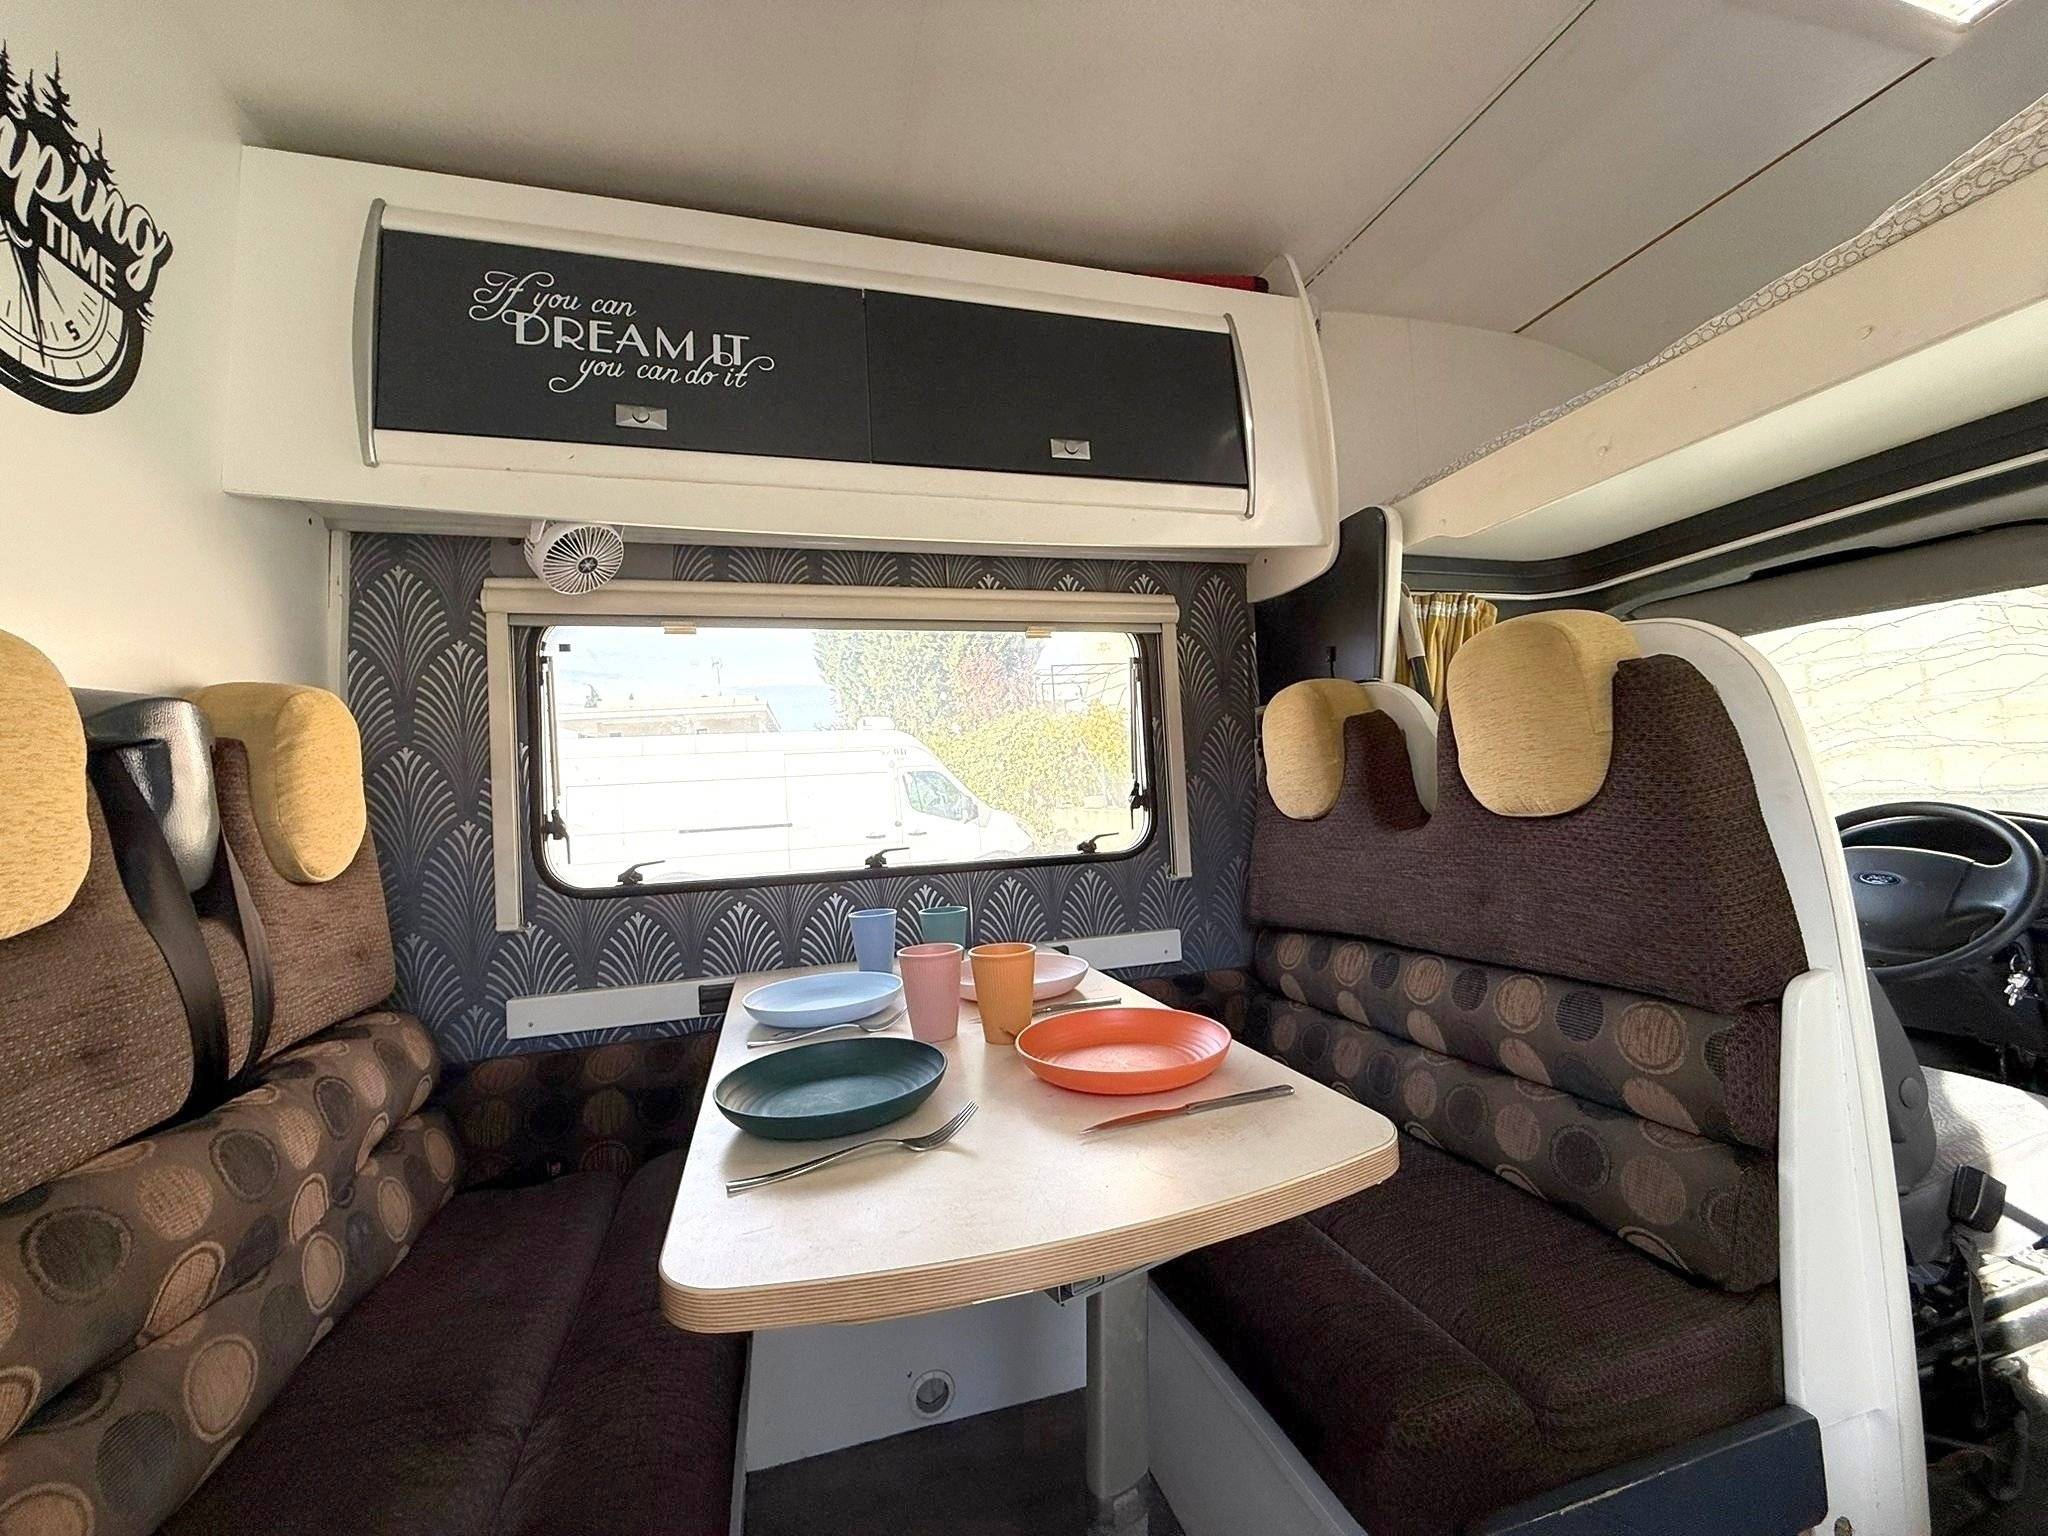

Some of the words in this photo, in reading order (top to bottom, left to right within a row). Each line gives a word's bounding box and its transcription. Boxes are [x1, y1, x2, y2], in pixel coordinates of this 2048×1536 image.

[40, 205, 117, 299] TIME
[468, 270, 555, 322] If
[501, 292, 582, 326] you
[591, 298, 637, 317] can
[514, 311, 695, 362] DREAM
[712, 333, 750, 367] IT
[548, 358, 626, 393] you
[636, 364, 682, 384] can
[684, 351, 734, 386] do
[723, 355, 775, 388] it
